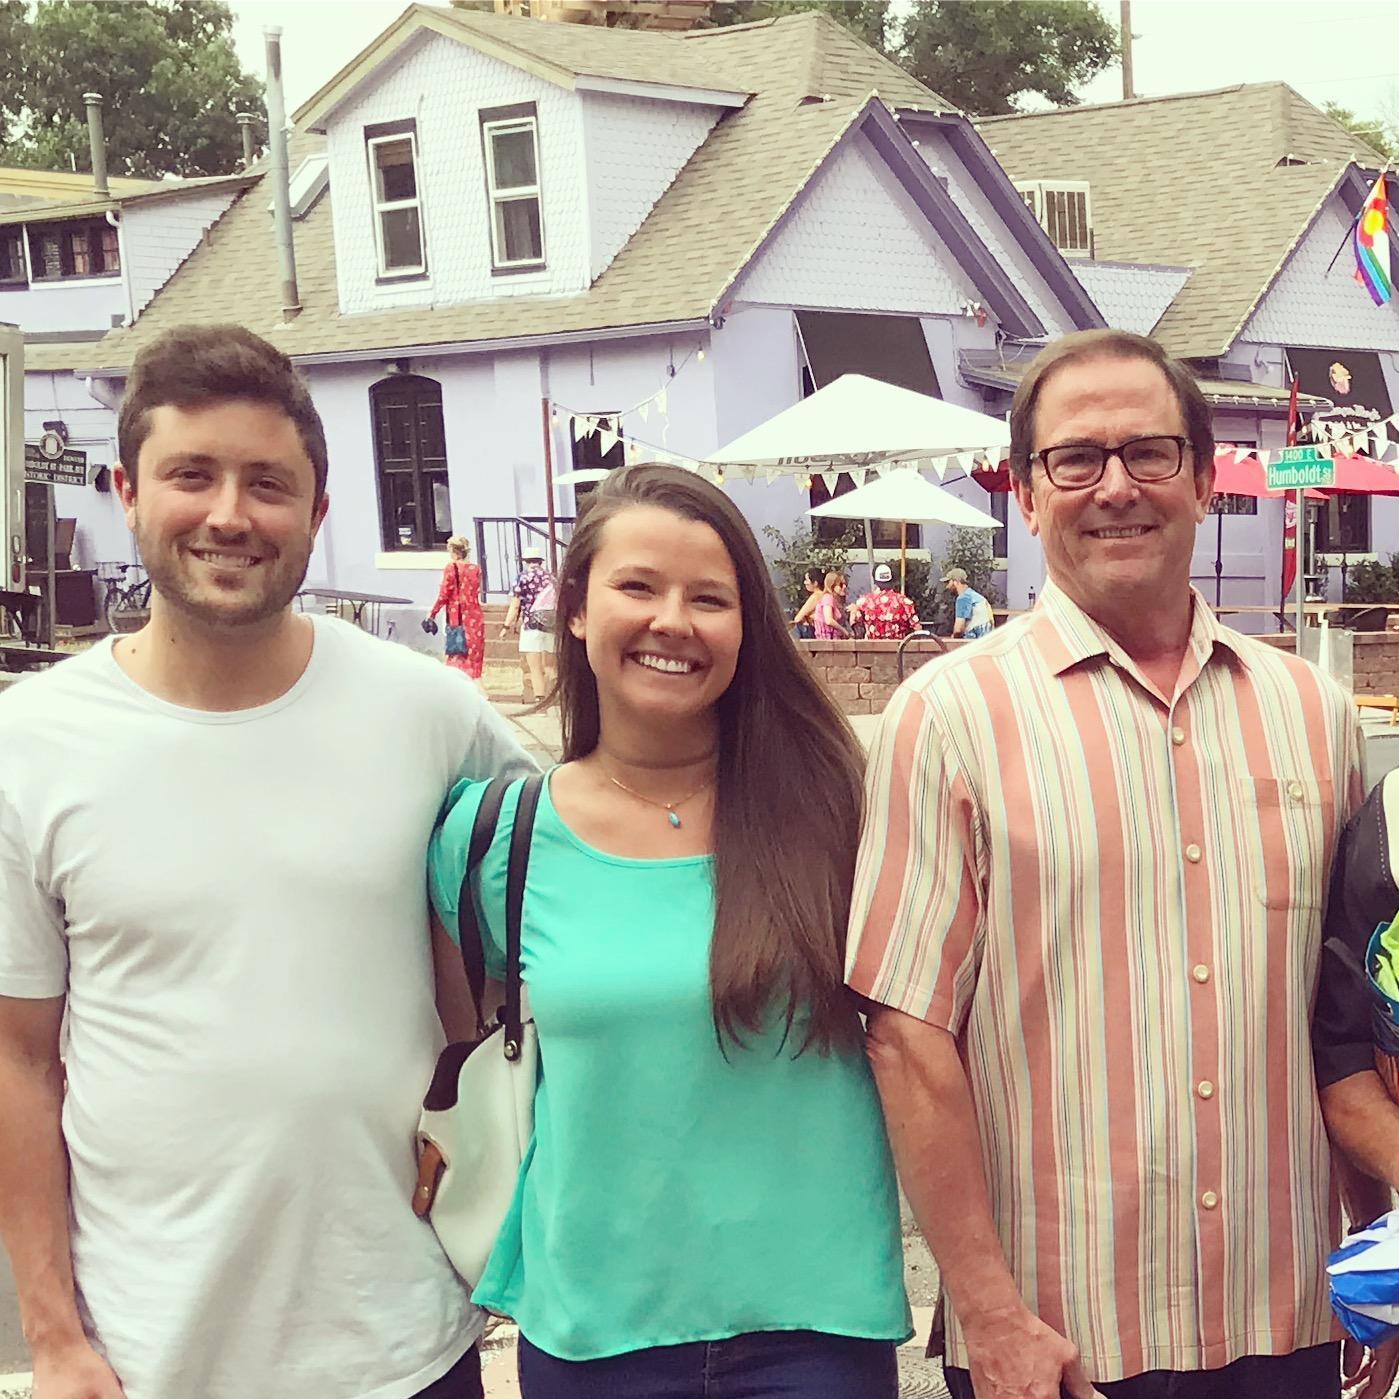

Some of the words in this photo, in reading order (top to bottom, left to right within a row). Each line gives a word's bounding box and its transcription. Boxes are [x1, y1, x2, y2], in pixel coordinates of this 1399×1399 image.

[1284, 450, 1304, 461] 1400
[1306, 449, 1314, 460] E
[1268, 464, 1322, 487] Humboldt
